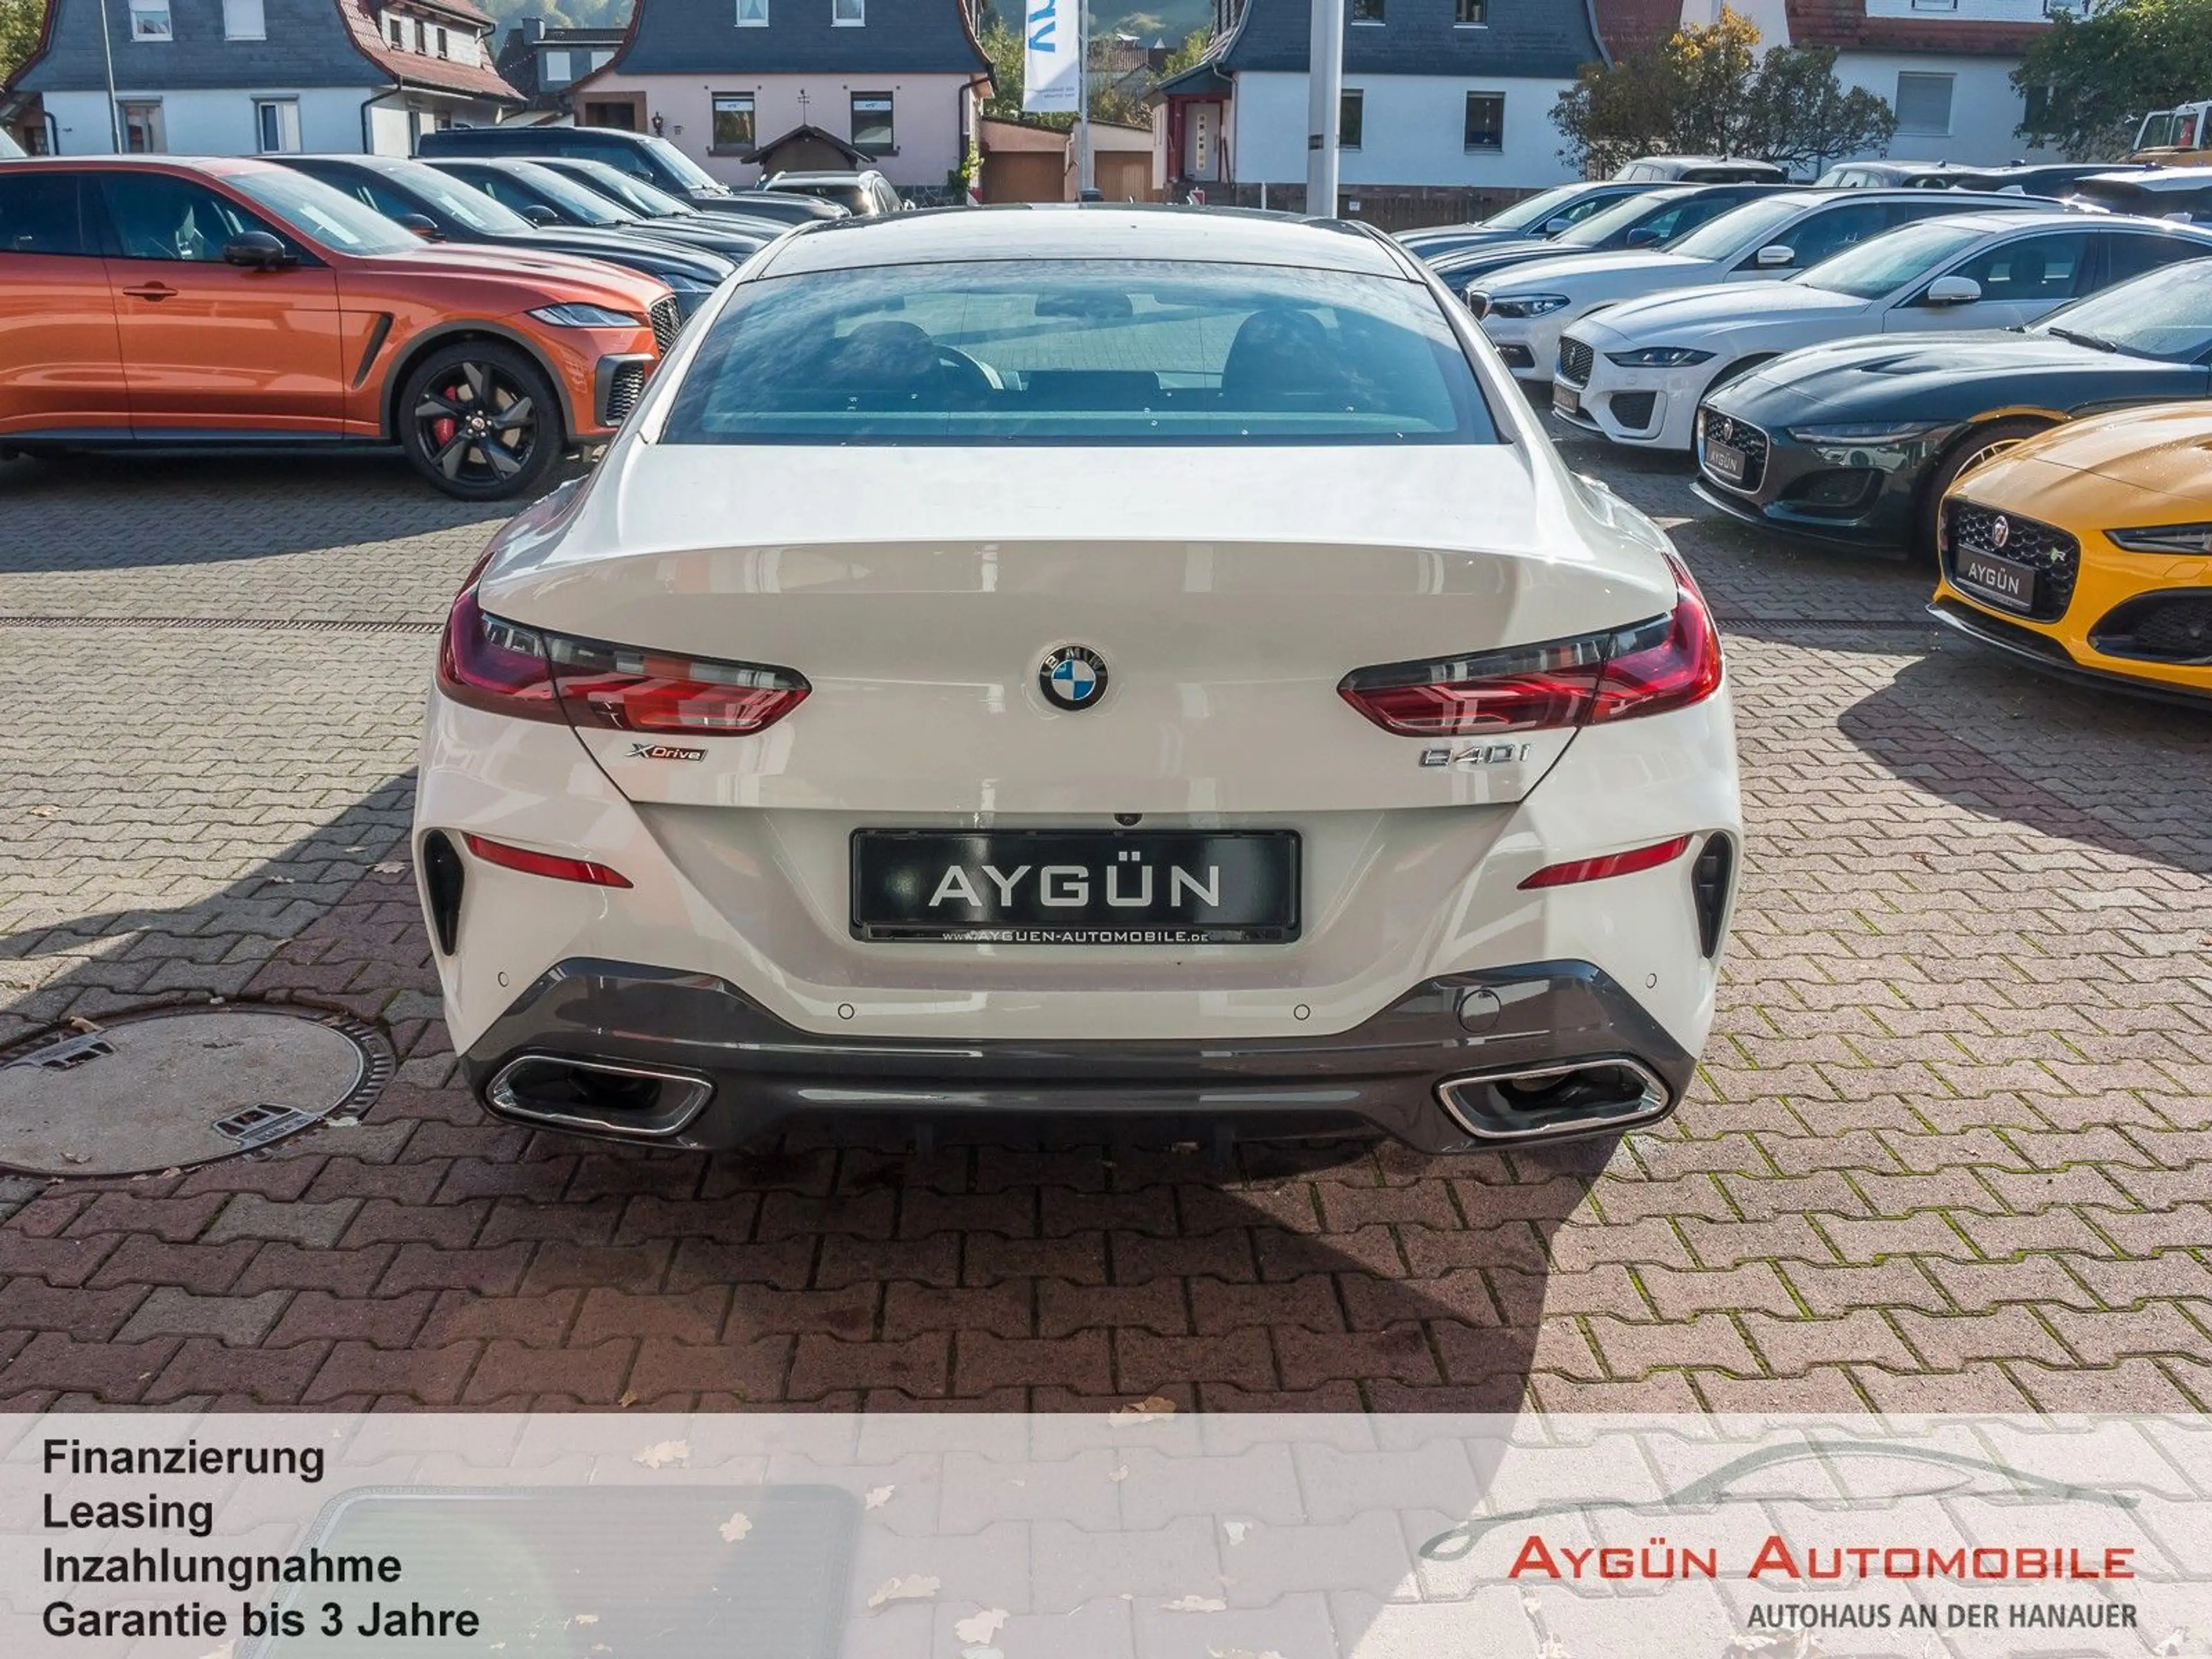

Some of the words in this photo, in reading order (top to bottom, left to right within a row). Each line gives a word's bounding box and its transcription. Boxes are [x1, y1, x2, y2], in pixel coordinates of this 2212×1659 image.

[1968, 562, 2019, 594] AYGÜN
[1045, 647, 1104, 670] BMW
[929, 851, 1219, 907] AYGÜN
